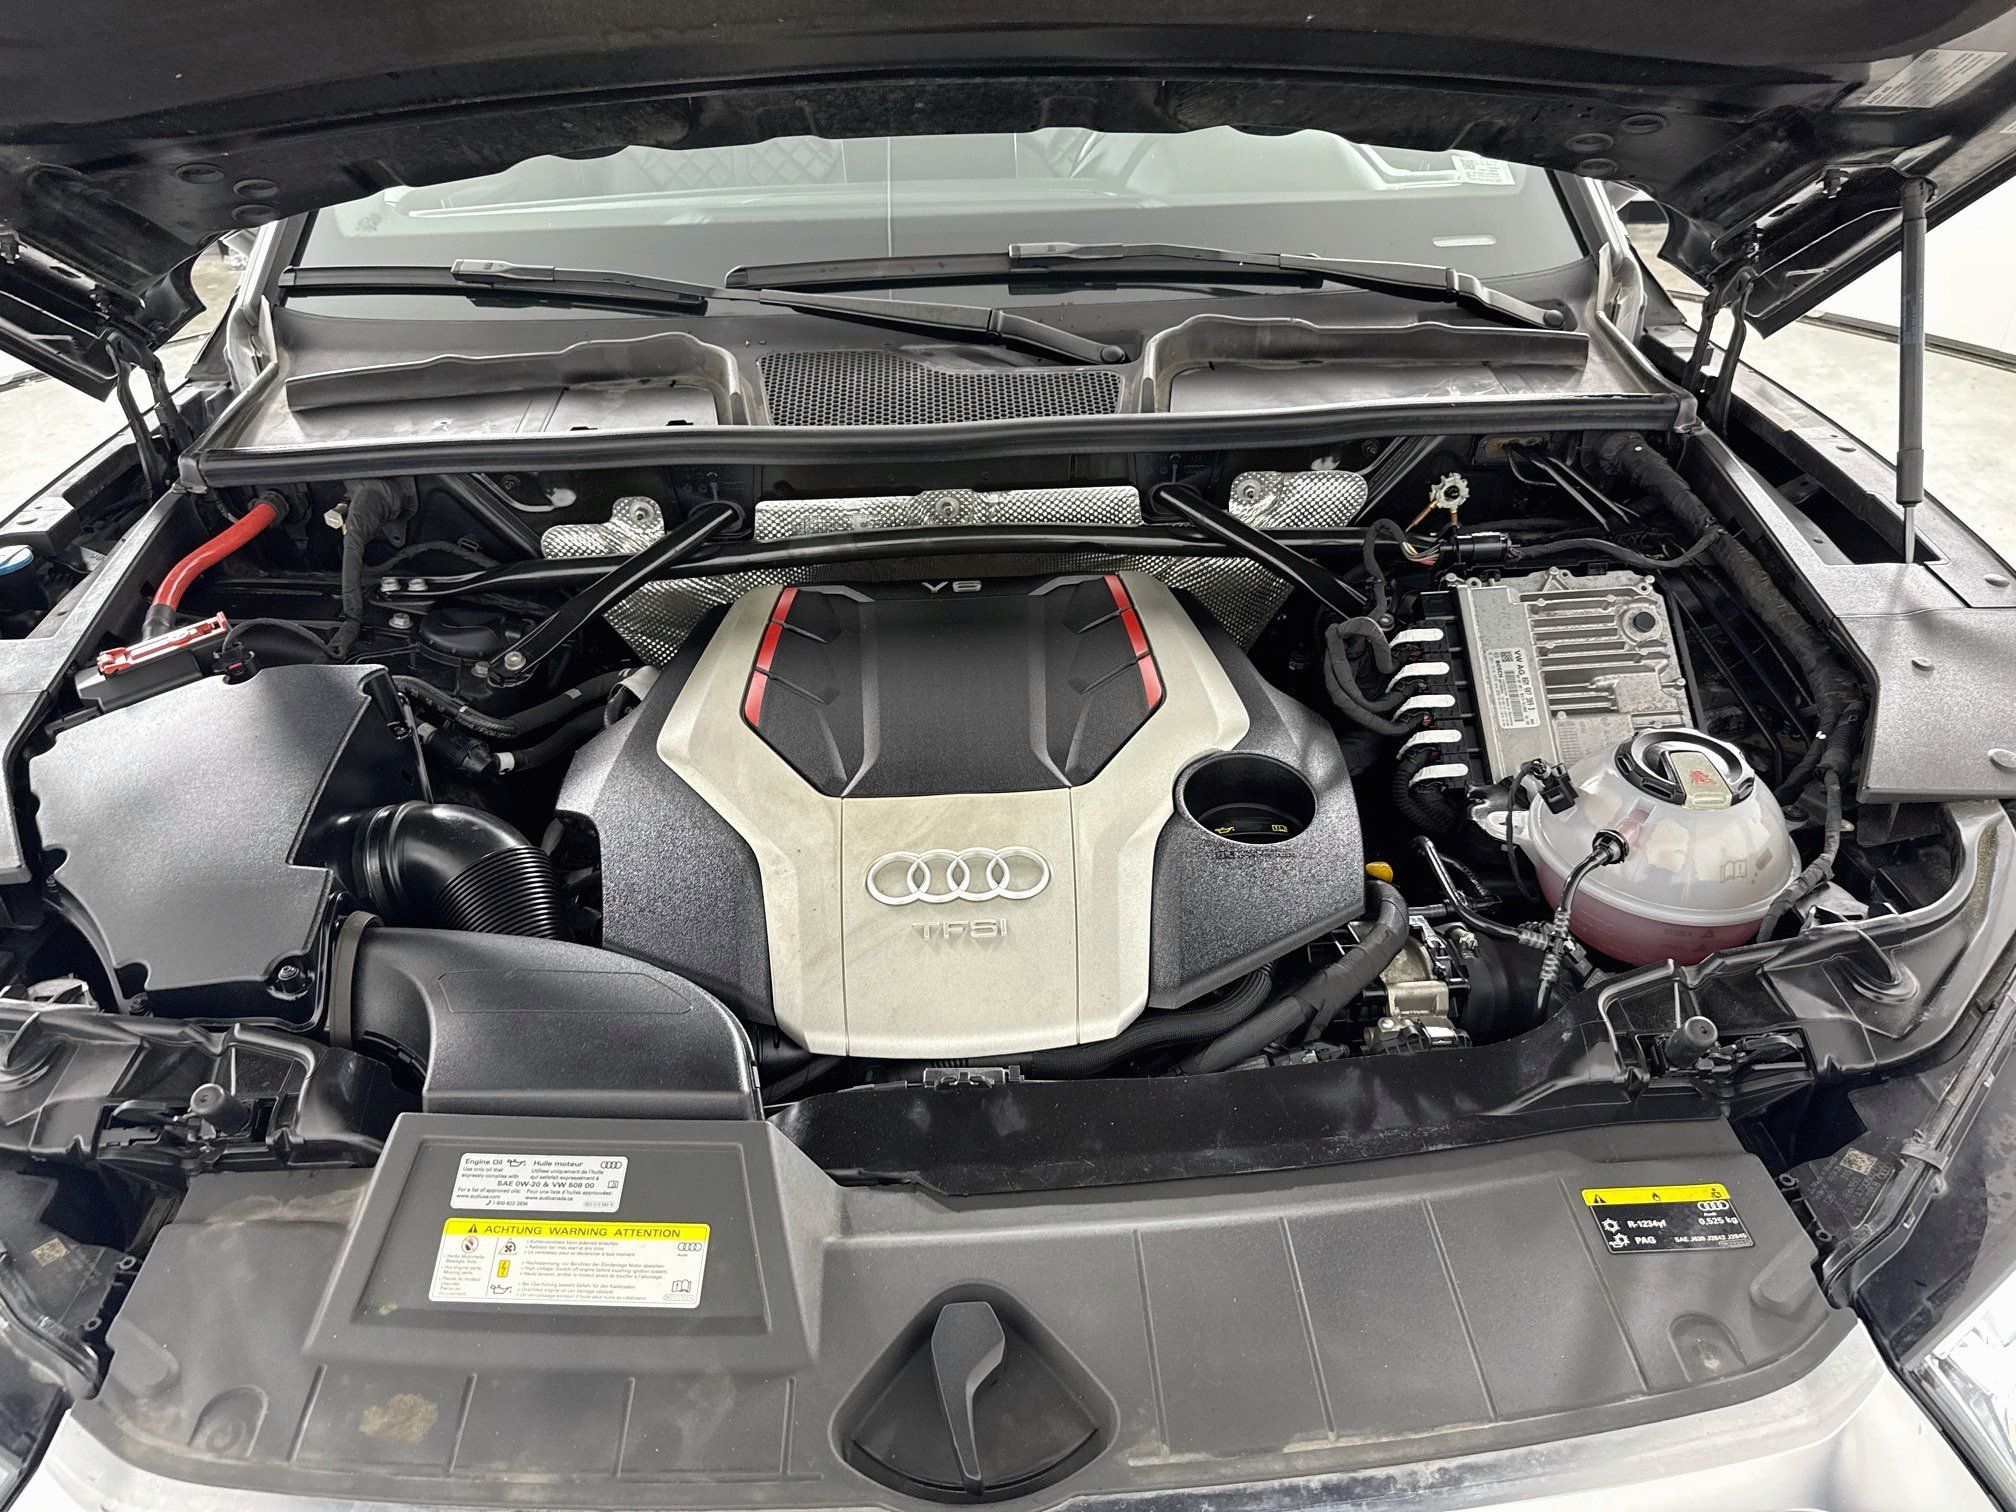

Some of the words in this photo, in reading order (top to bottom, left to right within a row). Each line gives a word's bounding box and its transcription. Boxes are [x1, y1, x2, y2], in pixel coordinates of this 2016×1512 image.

[1514, 650, 1523, 662] VW
[1495, 660, 1503, 677] BOSCH
[1517, 665, 1525, 675] AG
[911, 918, 1007, 940] TFSI
[465, 1158, 490, 1166] Engine
[1627, 1219, 1667, 1229] R-1234yf
[1698, 1218, 1724, 1226] 0,525
[1725, 1216, 1739, 1224] kg
[484, 1225, 543, 1235] ACHTUNG
[549, 1226, 608, 1236] WARNING
[613, 1228, 681, 1238] ATTENTION
[1634, 1236, 1657, 1245] PAG
